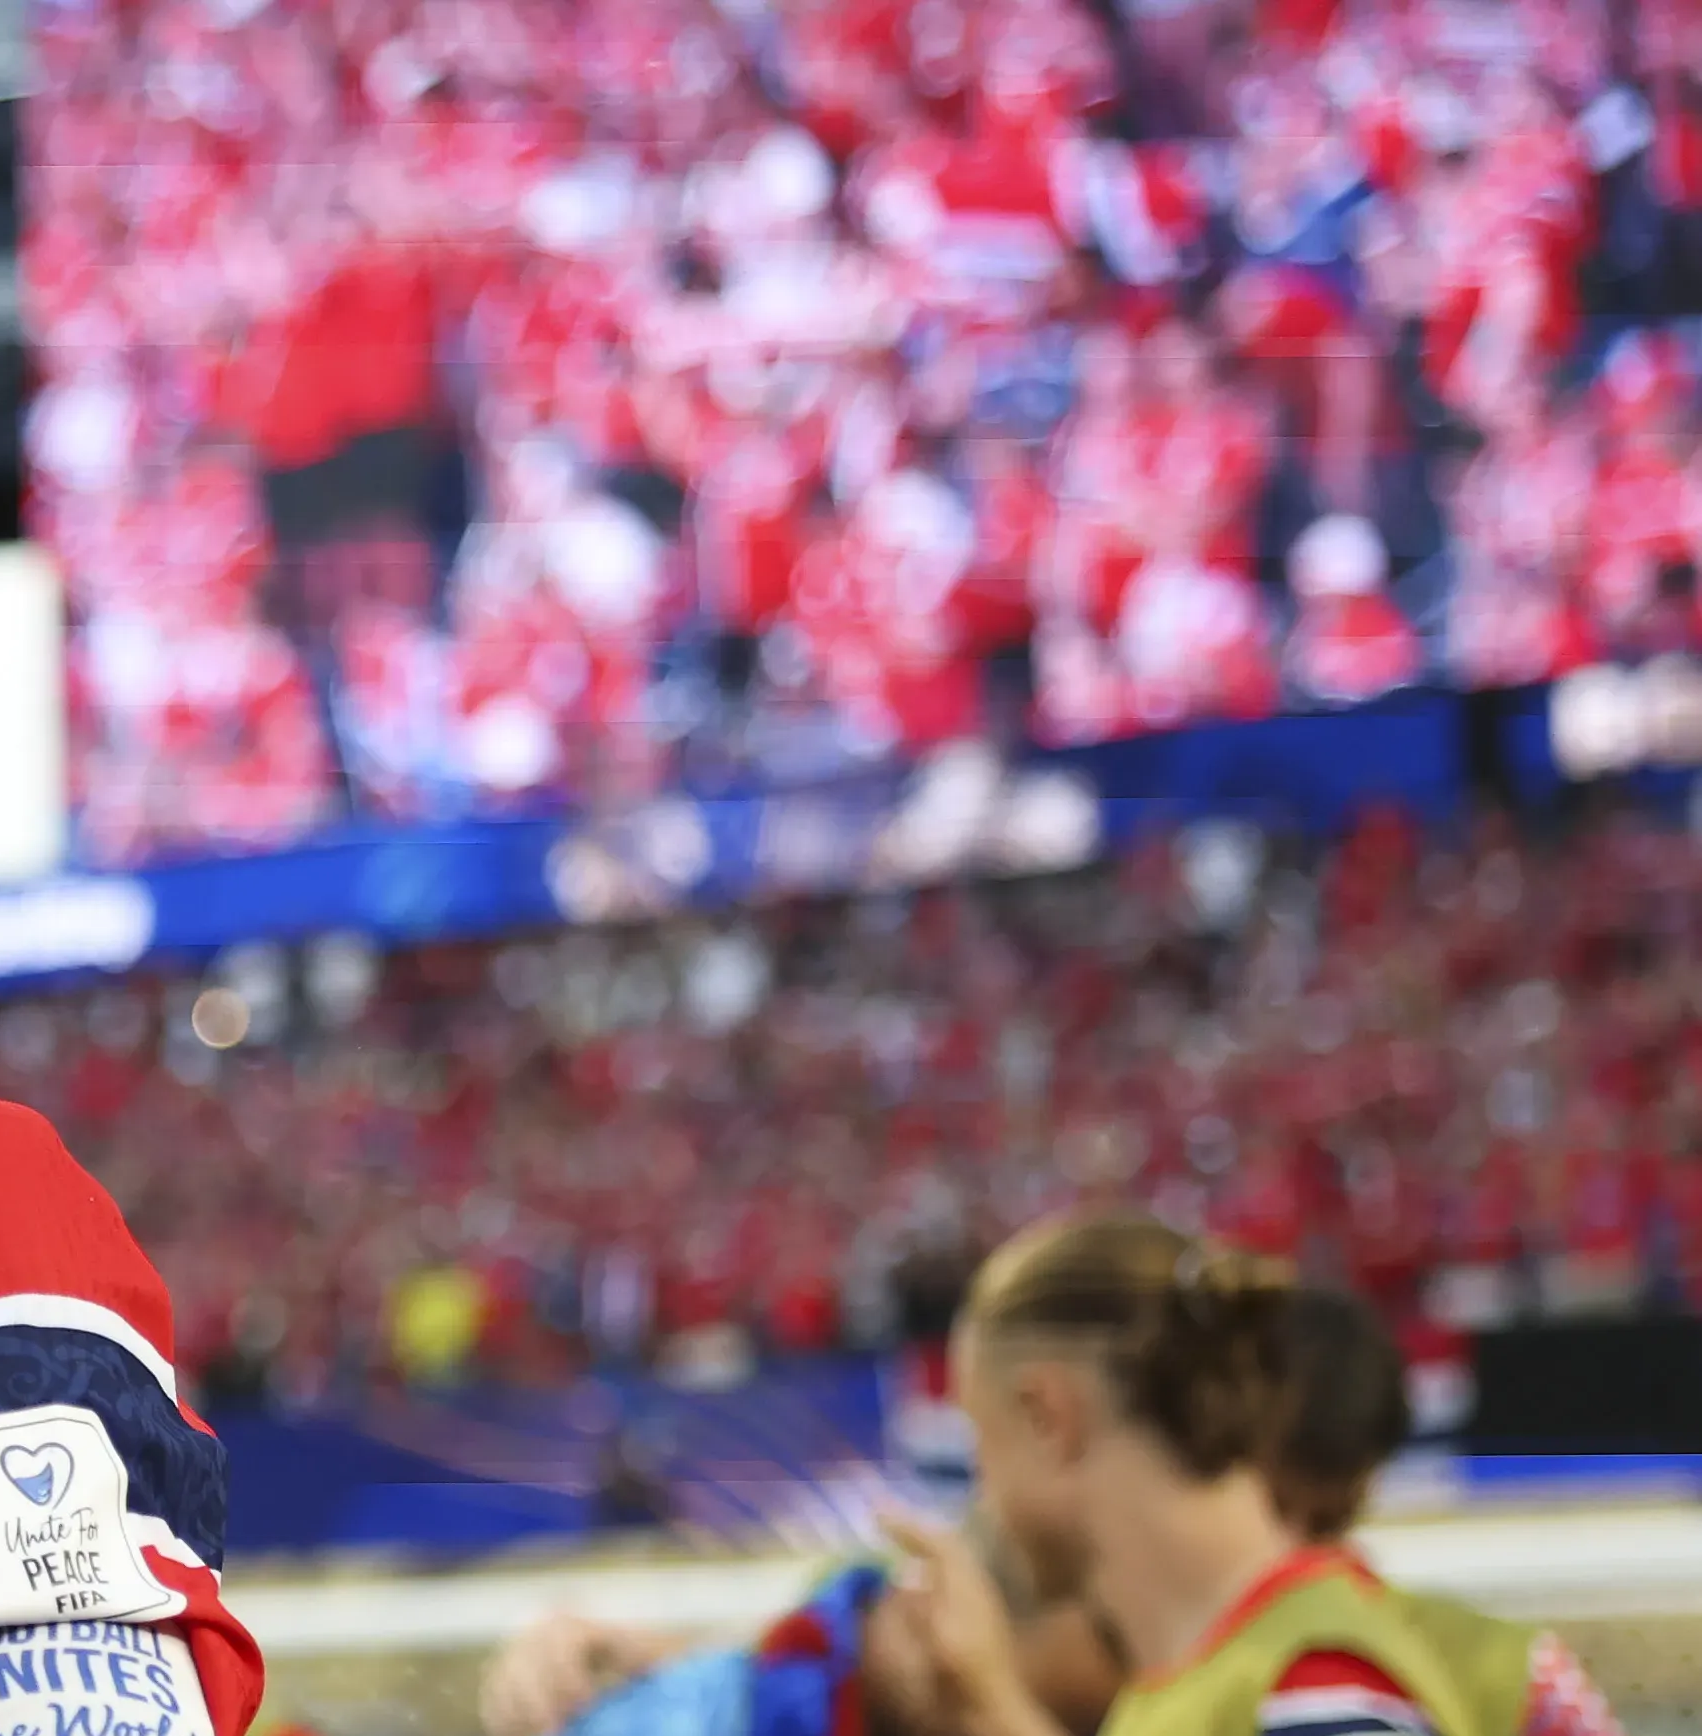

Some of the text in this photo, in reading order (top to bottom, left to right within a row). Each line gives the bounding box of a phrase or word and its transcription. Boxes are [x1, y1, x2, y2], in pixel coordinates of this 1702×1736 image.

[5, 1513, 72, 1556] Unite
[21, 1550, 110, 1592] PEACE
[55, 1590, 109, 1614] FIFA
